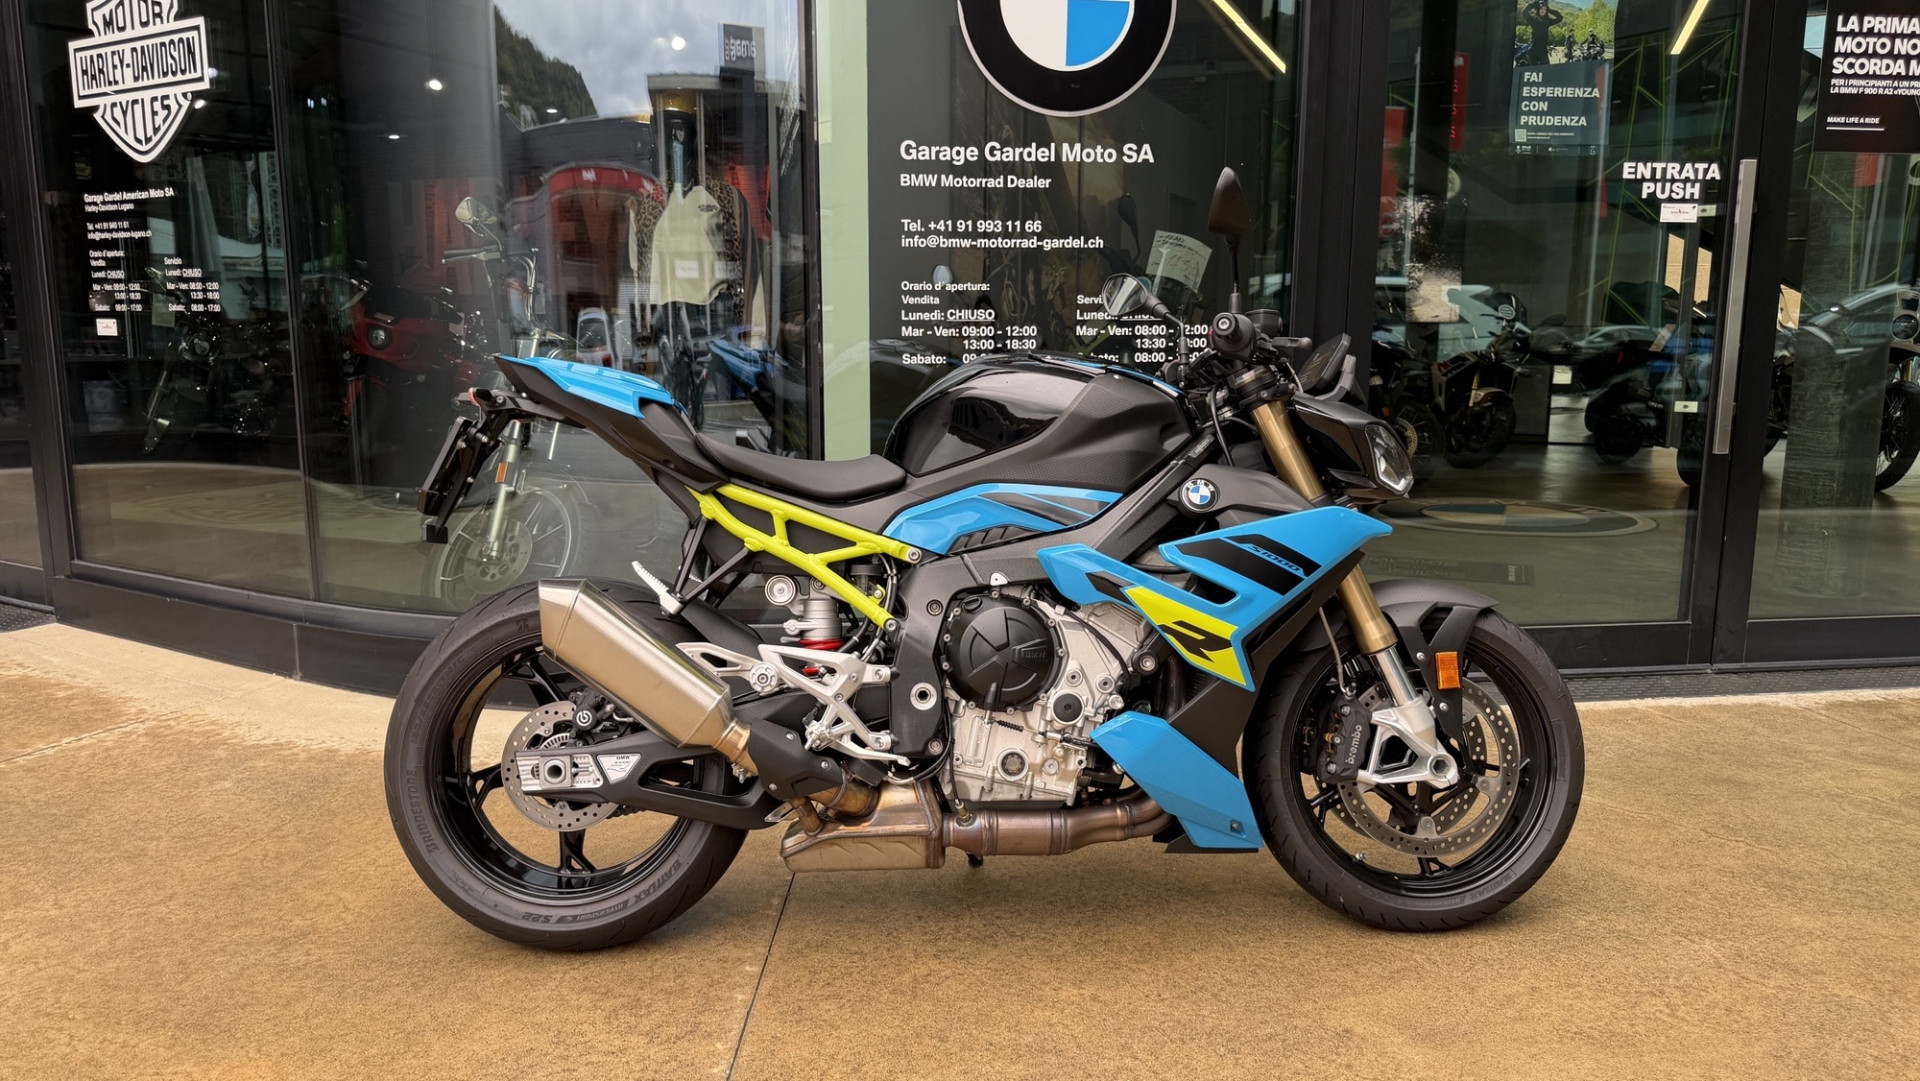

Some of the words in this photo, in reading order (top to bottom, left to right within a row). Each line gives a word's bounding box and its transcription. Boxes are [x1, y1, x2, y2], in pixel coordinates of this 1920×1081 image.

[102, 0, 164, 36] MOTOR
[1836, 15, 1859, 33] LA
[1862, 16, 1920, 34] PRIMA
[1834, 36, 1891, 55] MOTO
[1893, 38, 1920, 56] NO
[80, 36, 198, 91] HARLEY-DAVIDSON
[1832, 57, 1906, 76] SCORDA
[1523, 72, 1543, 83] FAI
[1830, 79, 1844, 87] PER
[1848, 79, 1892, 88] PRINCIPIANTI
[1893, 80, 1899, 88] A
[1900, 80, 1909, 88] UN
[1522, 87, 1600, 98] ESPERIENZA
[1521, 101, 1549, 112] CON
[110, 94, 172, 147] CYCLES
[1520, 115, 1588, 127] PRUDENZA
[900, 140, 979, 165] Garage
[984, 141, 1056, 162] Gardel
[1062, 143, 1118, 163] Moto
[1122, 143, 1155, 163] SA
[1622, 161, 1721, 180] ENTRATA
[900, 174, 938, 187] BMW
[941, 174, 1004, 188] Motorrad
[1007, 175, 1052, 188] Dealer
[84, 193, 103, 204] Garage
[104, 191, 122, 202] Gardel
[123, 190, 149, 201] American
[149, 188, 164, 198] Moto
[165, 187, 175, 197] SA
[1641, 182, 1700, 200] PUSH
[118, 202, 135, 211] Lugano
[901, 219, 925, 232] Tel.
[928, 220, 952, 232] +41
[956, 220, 972, 232] 91
[977, 220, 1002, 232] 993
[1006, 220, 1021, 232] 11
[1025, 220, 1042, 233] 66
[901, 234, 1104, 251] info@bmw-motorrad-gardel.ch
[164, 257, 182, 265] Servizio
[901, 281, 932, 291] Orario
[901, 294, 940, 305] Vendita
[1077, 294, 1104, 304] Servi
[901, 310, 945, 321] Lunedì:
[946, 309, 996, 322] CHIUSO
[901, 326, 924, 336] Mar
[934, 326, 960, 336] Ven:
[961, 326, 995, 336] 09:00
[1005, 326, 1037, 337] 12:00
[1076, 325, 1099, 336] Mar
[1107, 325, 1133, 336] Ven:
[1134, 324, 1167, 336] 08:00
[1177, 324, 1208, 335] 2:00
[963, 339, 995, 349] 13:00
[1005, 339, 1036, 349] 18:30
[1135, 338, 1166, 349] 13:30
[902, 353, 947, 365] Sabato:
[1134, 352, 1166, 363] 08:00
[1345, 724, 1362, 765] brembo
[407, 769, 440, 854] BRIDGESTONE
